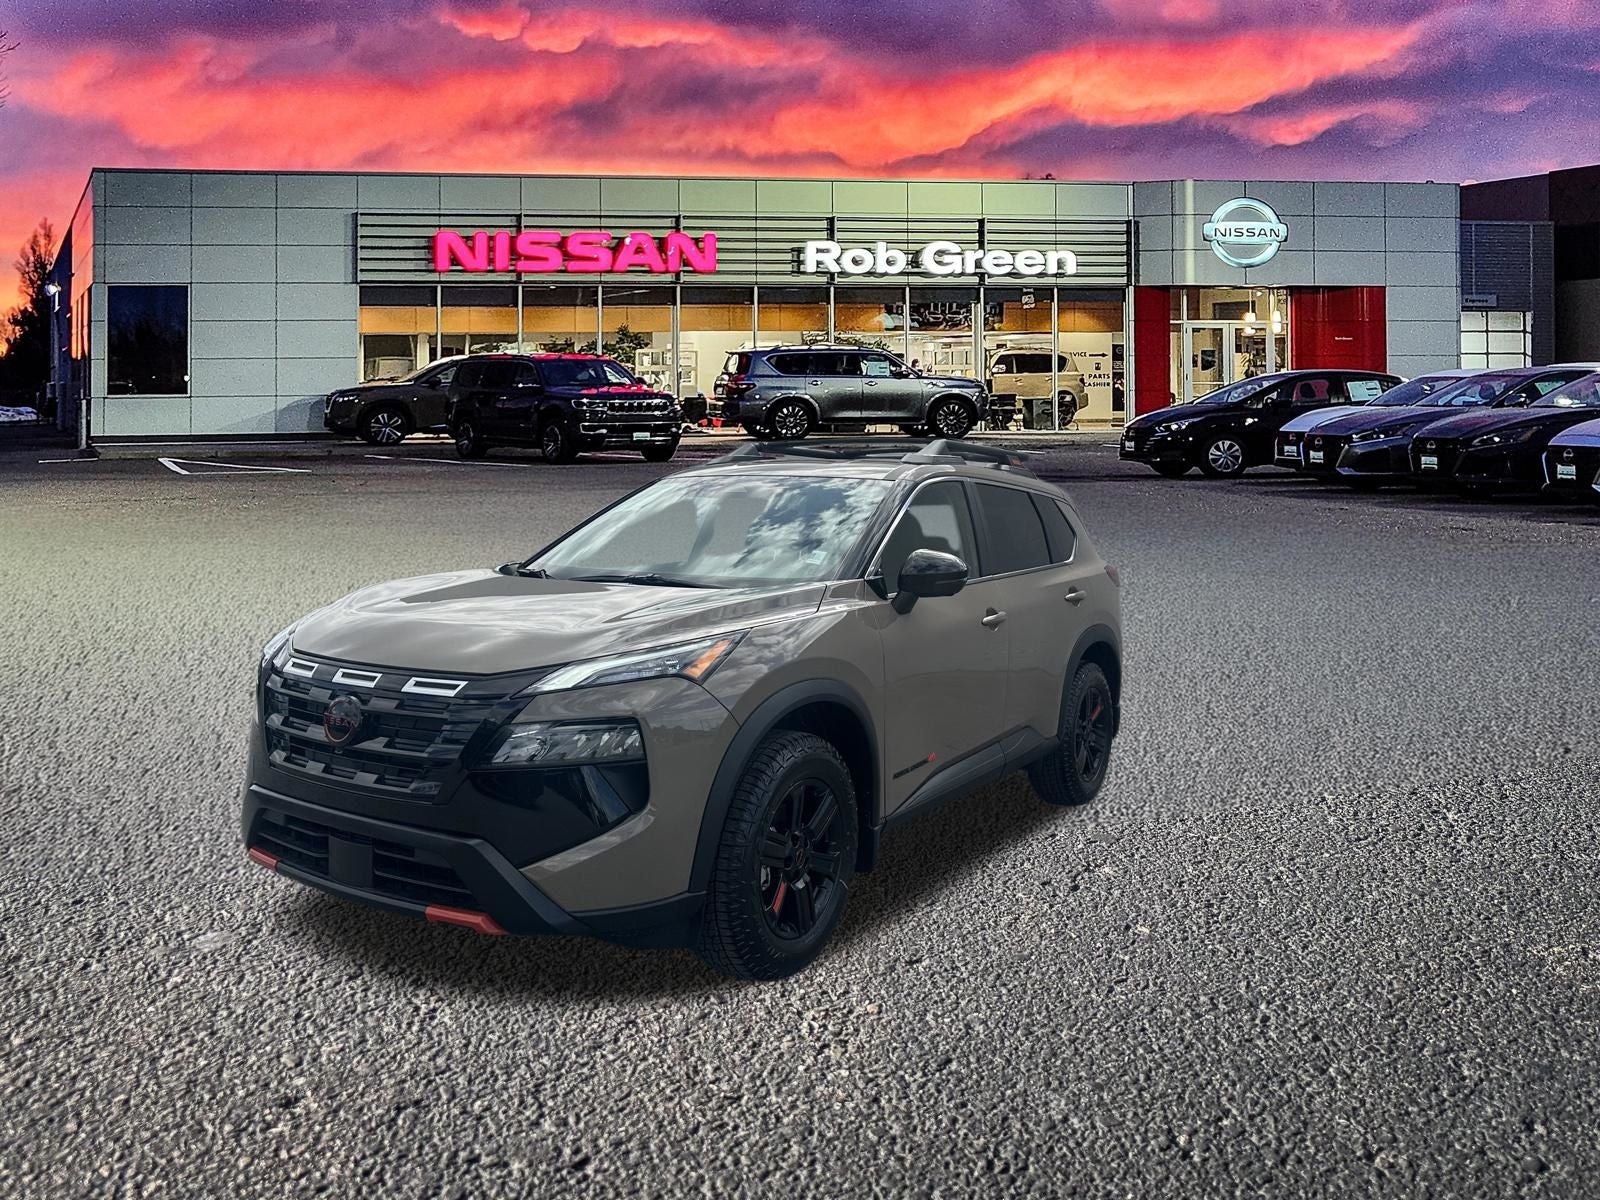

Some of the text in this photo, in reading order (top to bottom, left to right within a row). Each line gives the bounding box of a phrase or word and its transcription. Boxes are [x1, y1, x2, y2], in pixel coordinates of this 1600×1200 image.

[1214, 227, 1280, 238] NISSAN
[433, 230, 718, 273] NISSAN
[804, 240, 1078, 276] Rob Green
